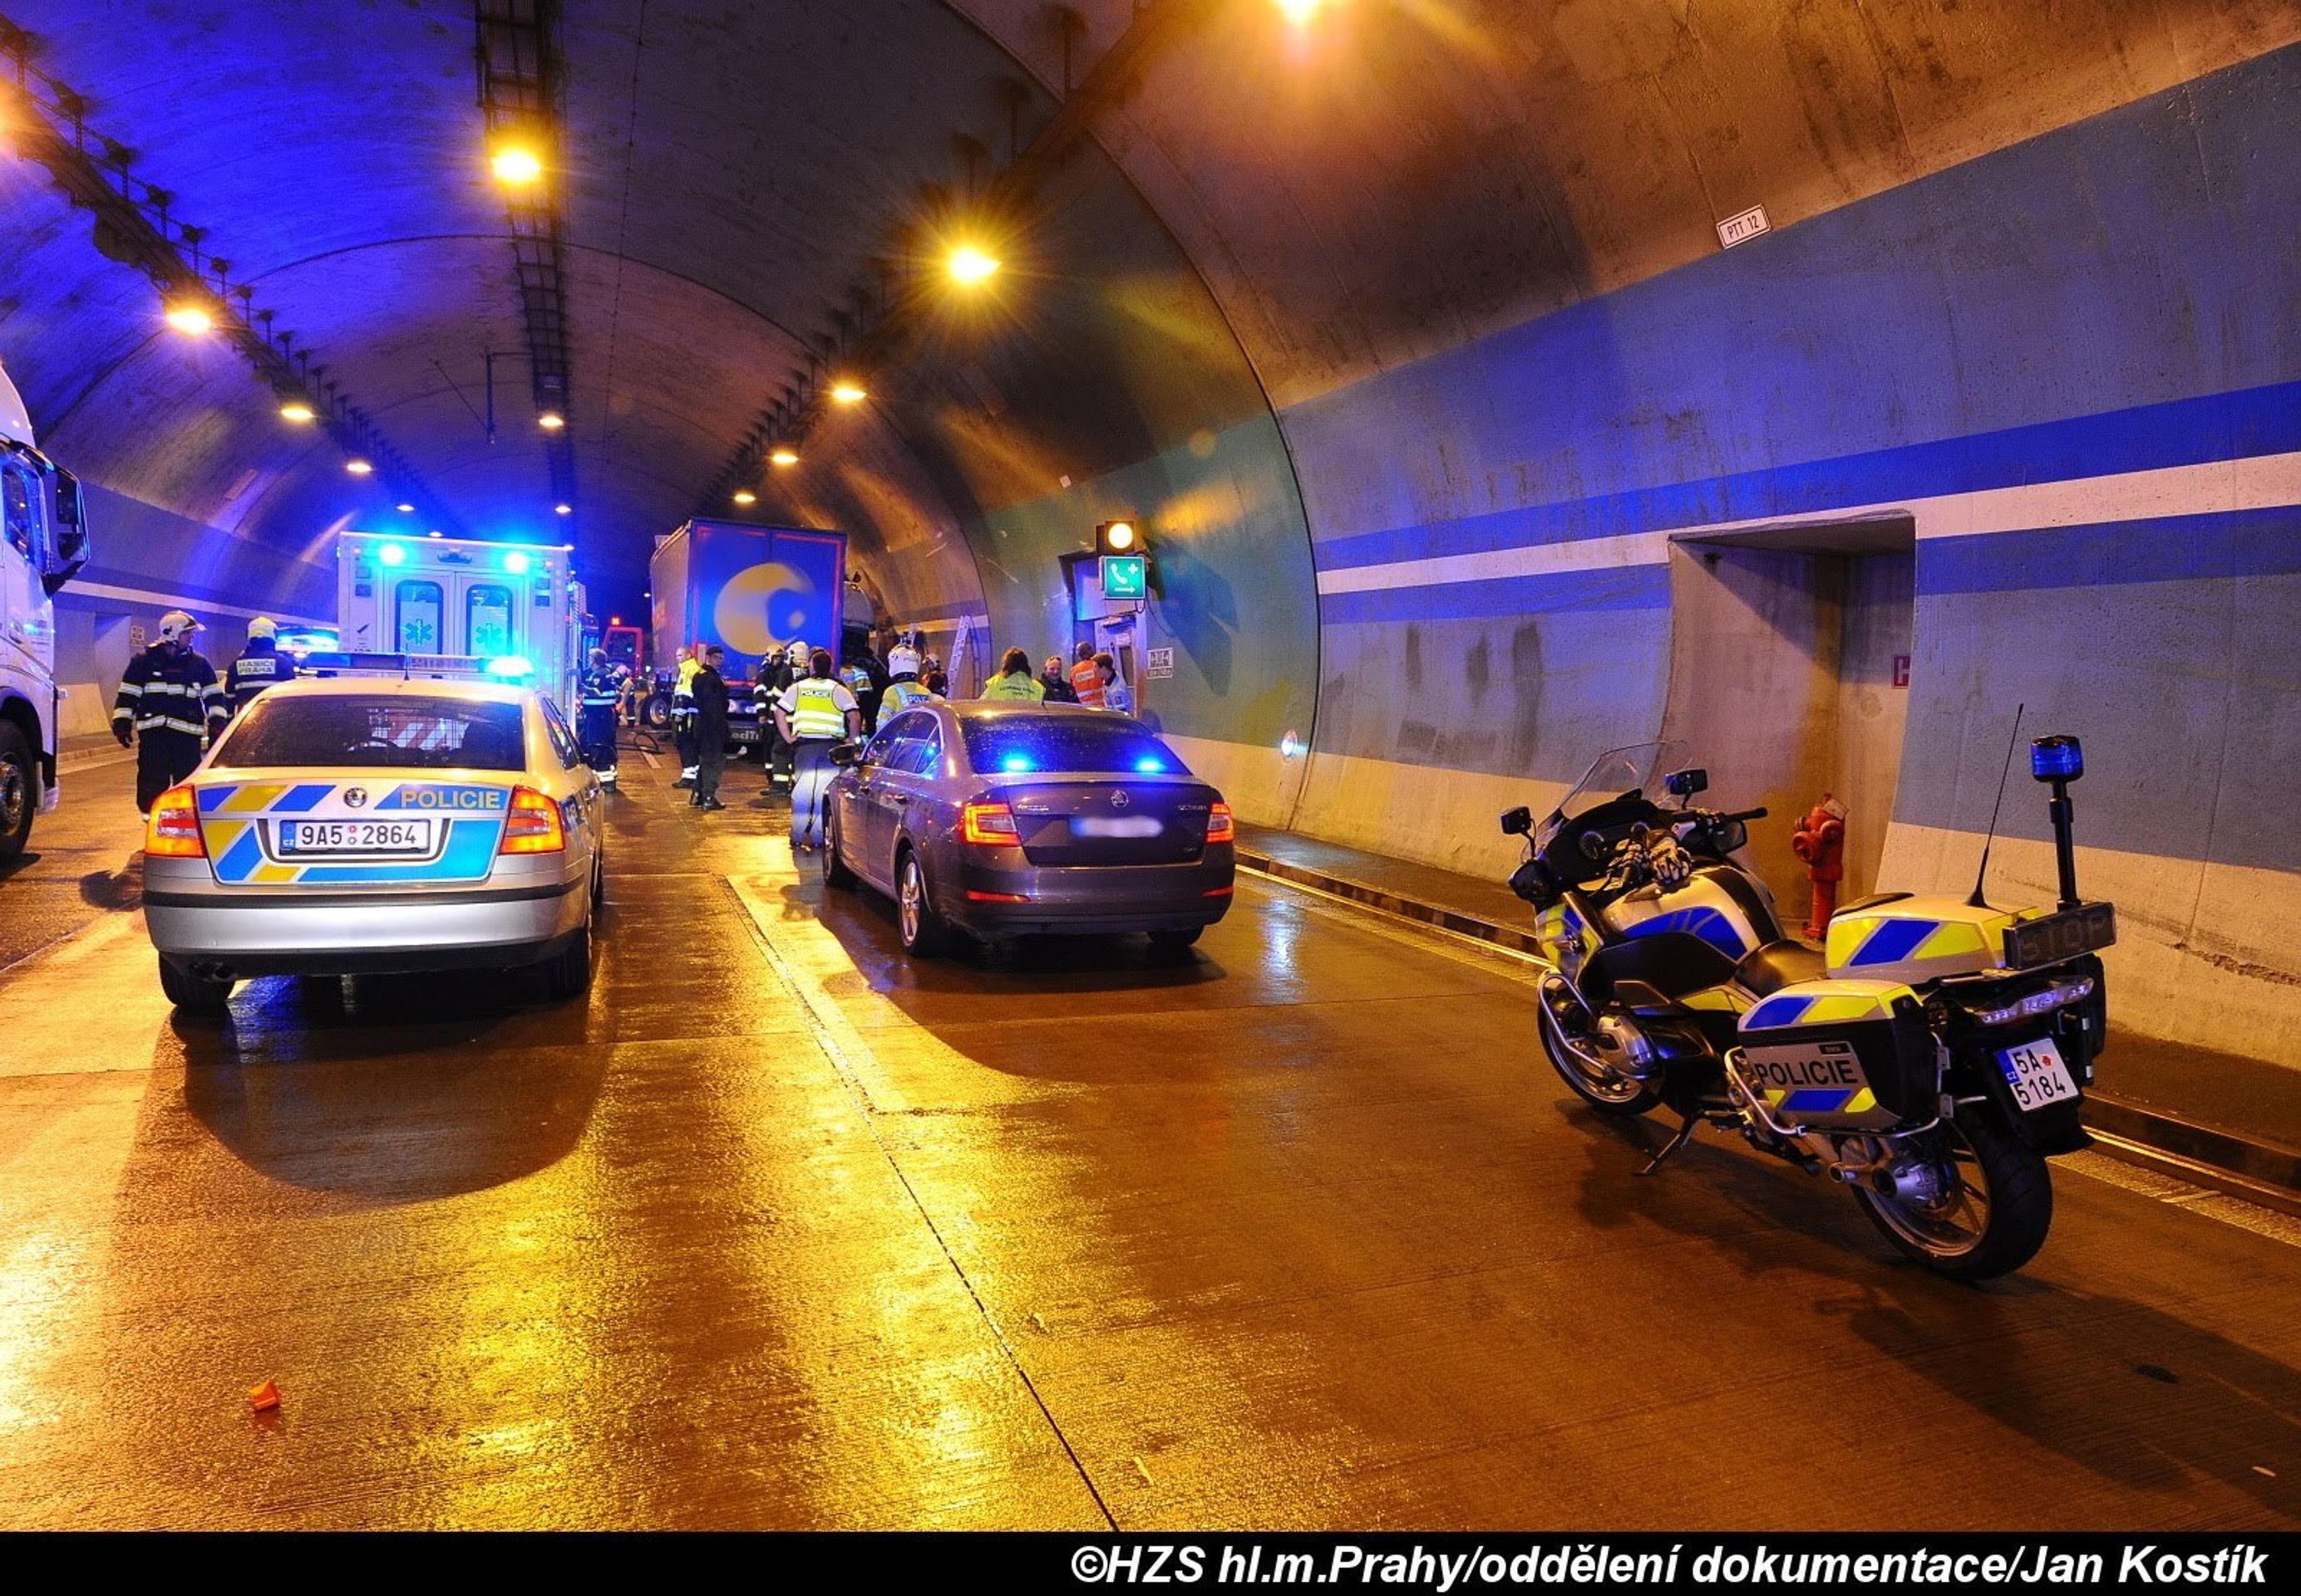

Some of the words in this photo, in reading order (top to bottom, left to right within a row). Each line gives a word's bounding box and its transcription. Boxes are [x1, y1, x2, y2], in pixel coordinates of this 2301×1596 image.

[1727, 221, 1744, 239] PTT
[1747, 215, 1759, 230] 12
[401, 790, 500, 809] POLICIE
[302, 825, 342, 845] 9A5
[362, 825, 416, 845] 2864
[2021, 919, 2106, 962] STOP
[1753, 1060, 1859, 1085] POLICIE
[2013, 1049, 2042, 1074] 5A
[2006, 1071, 2017, 1081] CZ
[2015, 1071, 2067, 1106] 5184
